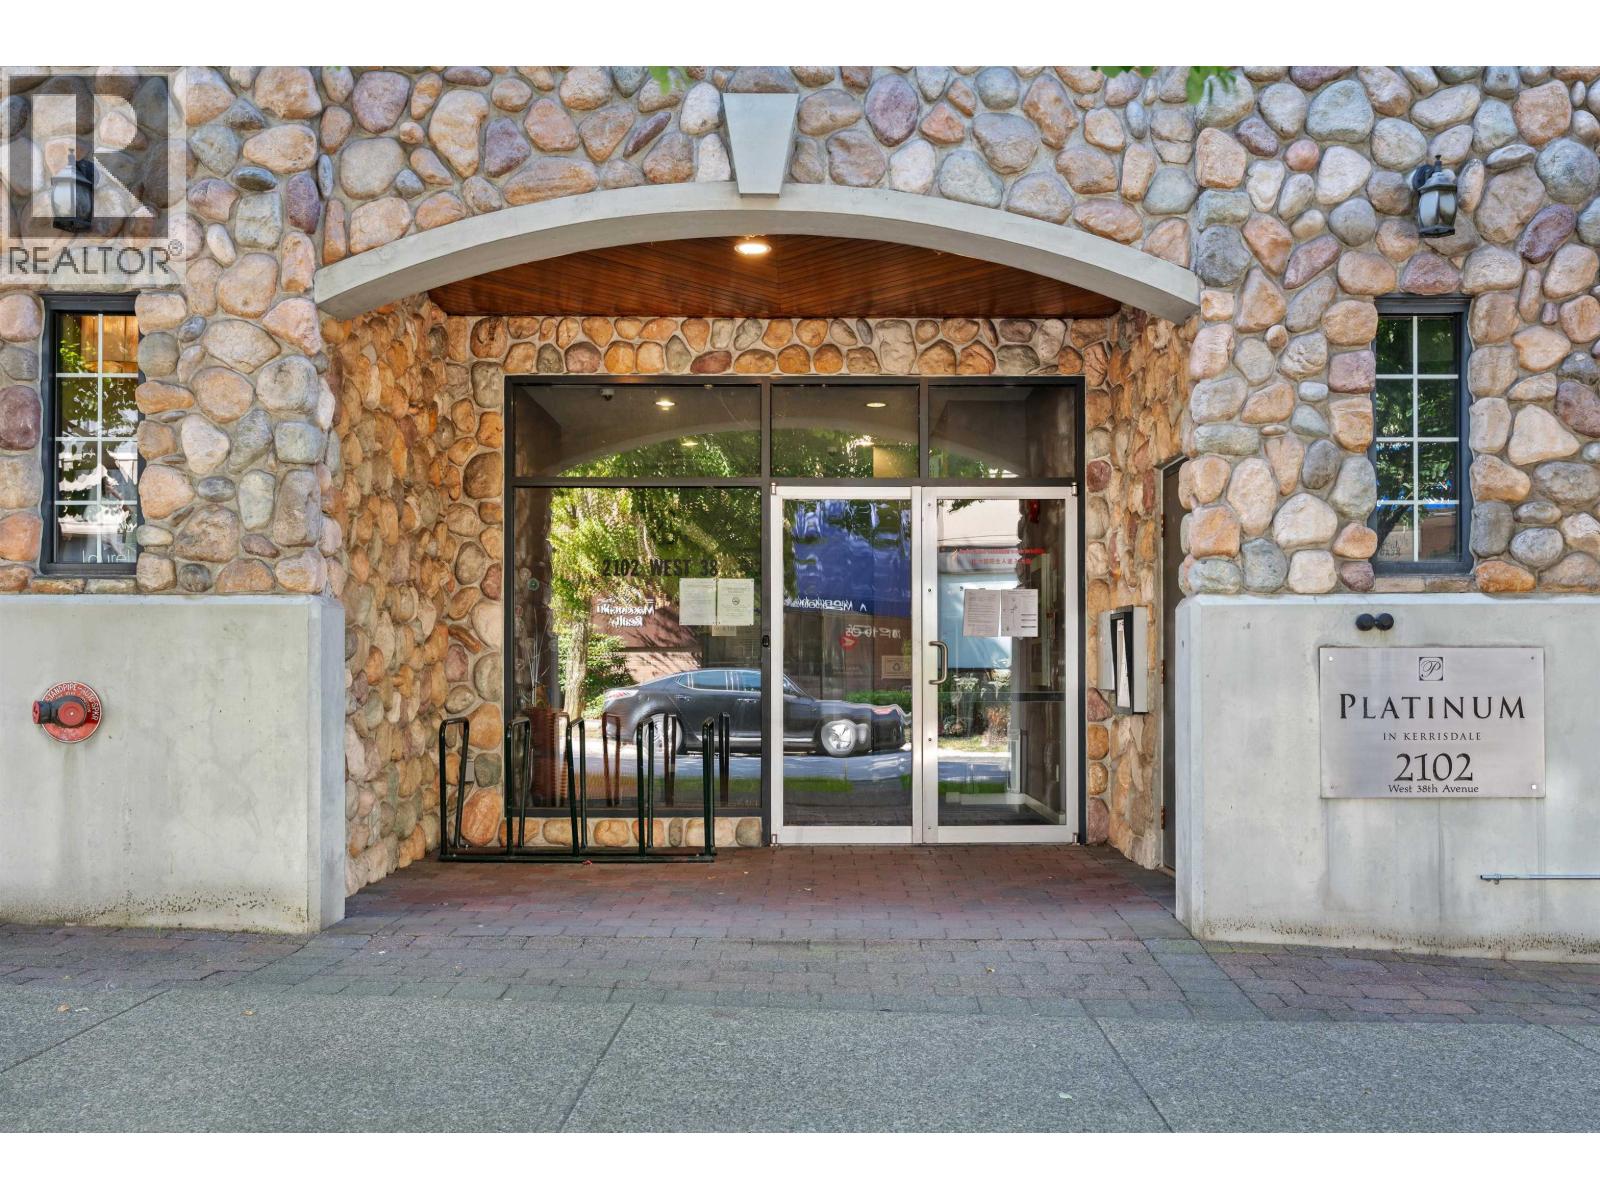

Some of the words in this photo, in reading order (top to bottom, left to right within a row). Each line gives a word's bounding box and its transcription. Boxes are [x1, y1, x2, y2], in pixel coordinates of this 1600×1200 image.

[602, 559, 640, 577] 2102
[650, 559, 691, 577] WEST
[1339, 693, 1526, 720] PLATINUM
[1383, 732, 1397, 741] IN
[1404, 732, 1482, 741] KERRISDALE
[1393, 752, 1474, 782] 2102
[1388, 784, 1413, 793] West
[1416, 783, 1438, 793] 38th
[1442, 784, 1480, 793] Avenue
